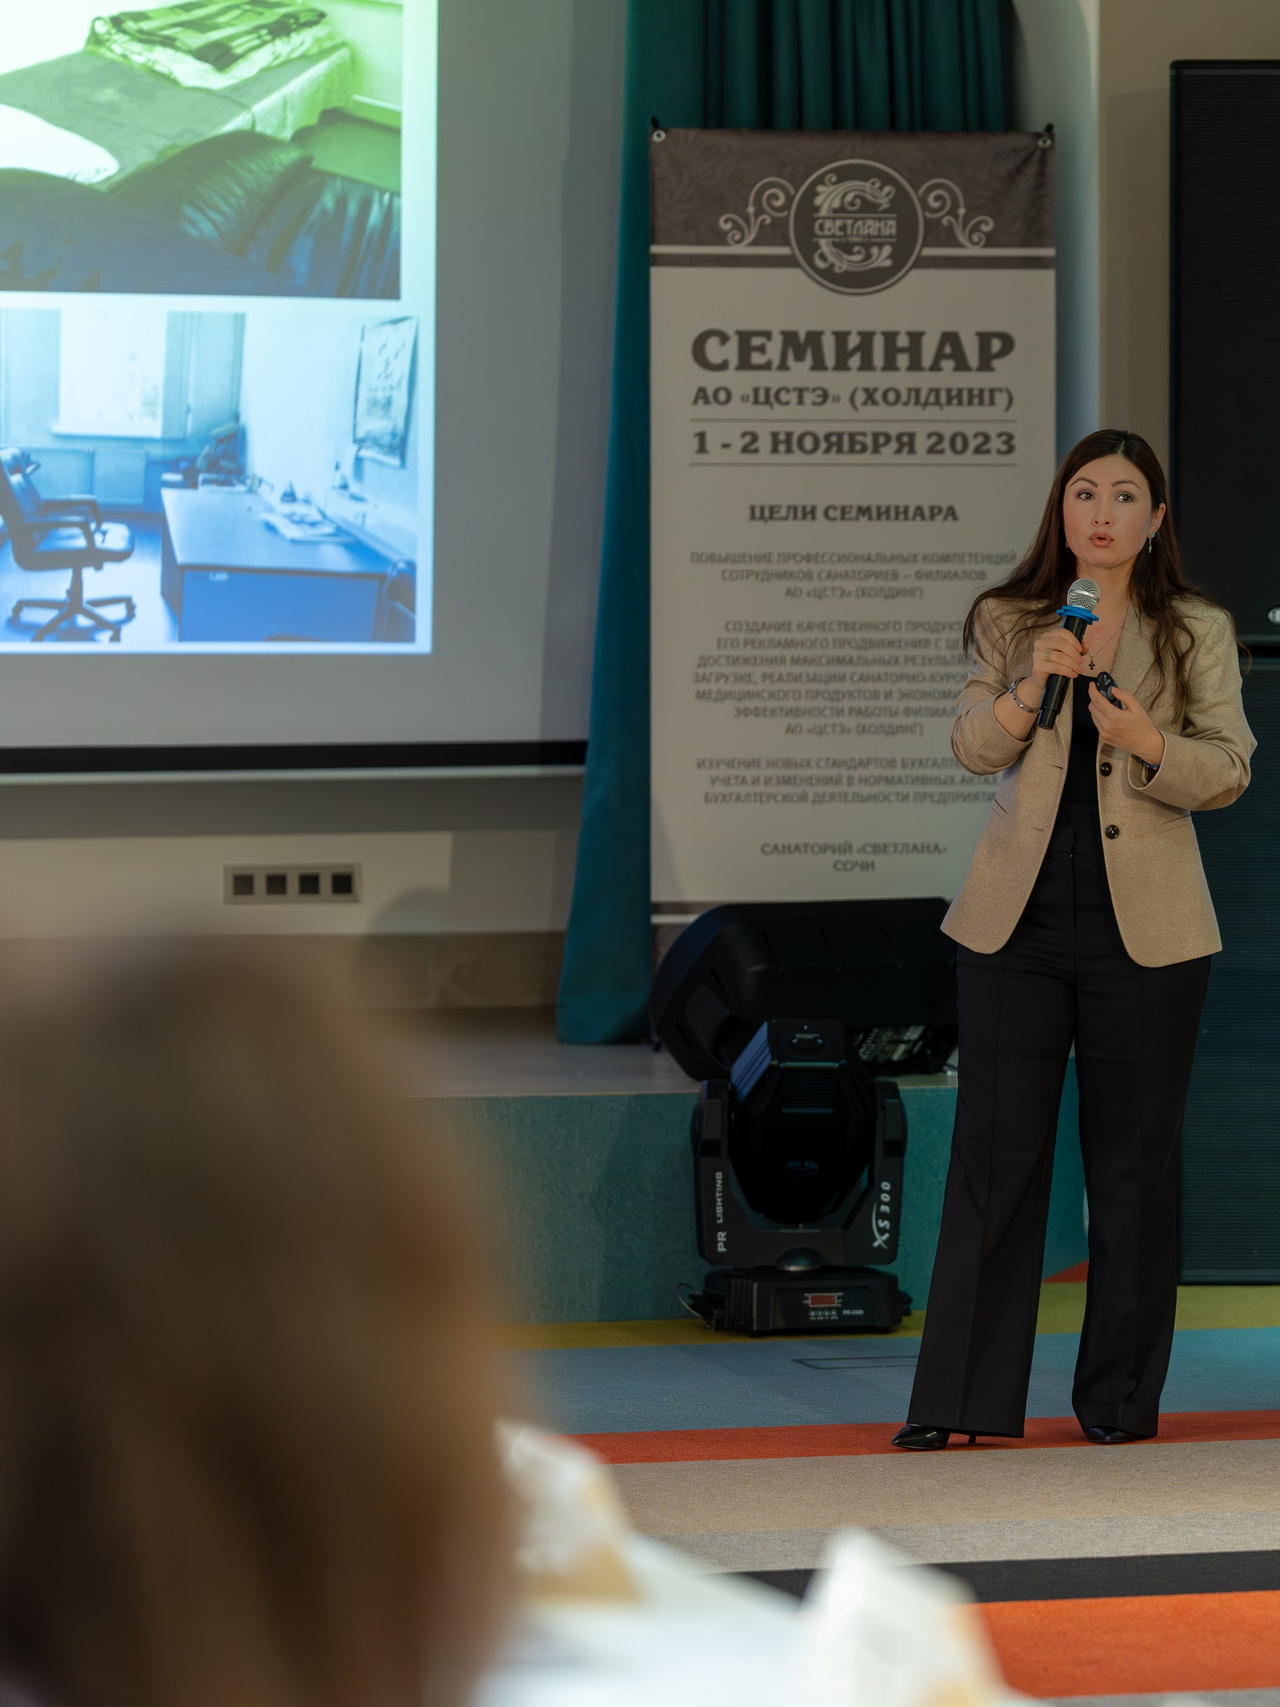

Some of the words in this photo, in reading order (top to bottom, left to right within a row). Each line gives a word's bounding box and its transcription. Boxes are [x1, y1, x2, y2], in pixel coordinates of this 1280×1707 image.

[813, 218, 897, 236] СВЕТЛАНА
[691, 327, 1016, 373] СЕМИНАР
[691, 386, 733, 407] АО
[740, 386, 841, 411] «ЦСТЭ»
[849, 386, 1015, 412] (ХОЛДИНГ)
[692, 430, 710, 454] 1
[739, 431, 760, 454] 2
[769, 431, 917, 454] НОЯБРЯ
[926, 431, 1017, 455] 2023
[749, 504, 817, 523] ЦЕЛИ
[823, 504, 960, 522] СЕМИНАРА
[690, 552, 773, 564] ПОВЫШЕНИЕ
[776, 552, 919, 564] ПРОФЕССИОНАЛЬНЫХ
[721, 569, 814, 582] СОТРУДНИКОВ
[817, 569, 899, 582] САНАТОРИЕВ
[914, 569, 988, 581] ФИЛИАЛОВ
[784, 587, 804, 599] АО
[855, 586, 924, 600] (ХОЛДИНГ)
[724, 620, 793, 633] СОЗДАНИЕ
[795, 620, 902, 633] КАЧЕСТВЕННОГО
[717, 637, 740, 650] ЕГО
[743, 637, 829, 650] РЕКЛАМНОГО
[832, 637, 932, 651] ПРОДВИЖЕНИЯ
[697, 654, 786, 667] ДОСТИЖЕНИЯ
[788, 654, 900, 667] МАКСИМАЛЬНЫХ
[761, 671, 846, 684] РЕАЛИЗАЦИИ
[695, 688, 801, 702] МЕДИЦИНСКОГО
[804, 688, 880, 702] ПРОДУКТОВ
[883, 688, 893, 700] И
[734, 706, 845, 719] ЭФФЕКТИВНОСТИ
[848, 706, 899, 718] РАБОТЫ
[784, 723, 803, 735] АО
[855, 722, 924, 737] (ХОЛДИНГ)
[696, 757, 762, 770] ИЗУЧЕНИЕ
[765, 757, 812, 770] НОВЫХ
[815, 757, 897, 771] СТАНДАРТОВ
[709, 774, 748, 787] УЧЕТА
[751, 774, 761, 786] И
[764, 773, 843, 787] ИЗМЕНЕНИЙ
[846, 774, 855, 786] В
[858, 774, 956, 787] НОРМАТИВНЫХ
[704, 790, 808, 804] БУХГАЛТЕРСКОЙ
[811, 791, 911, 805] ДЕЯТЕЛЬНОСТИ
[760, 840, 853, 855] САНАТОРИЙ
[832, 859, 876, 872] СОЧИ
[715, 1171, 724, 1224] LIGHTING
[717, 1231, 727, 1253] PR
